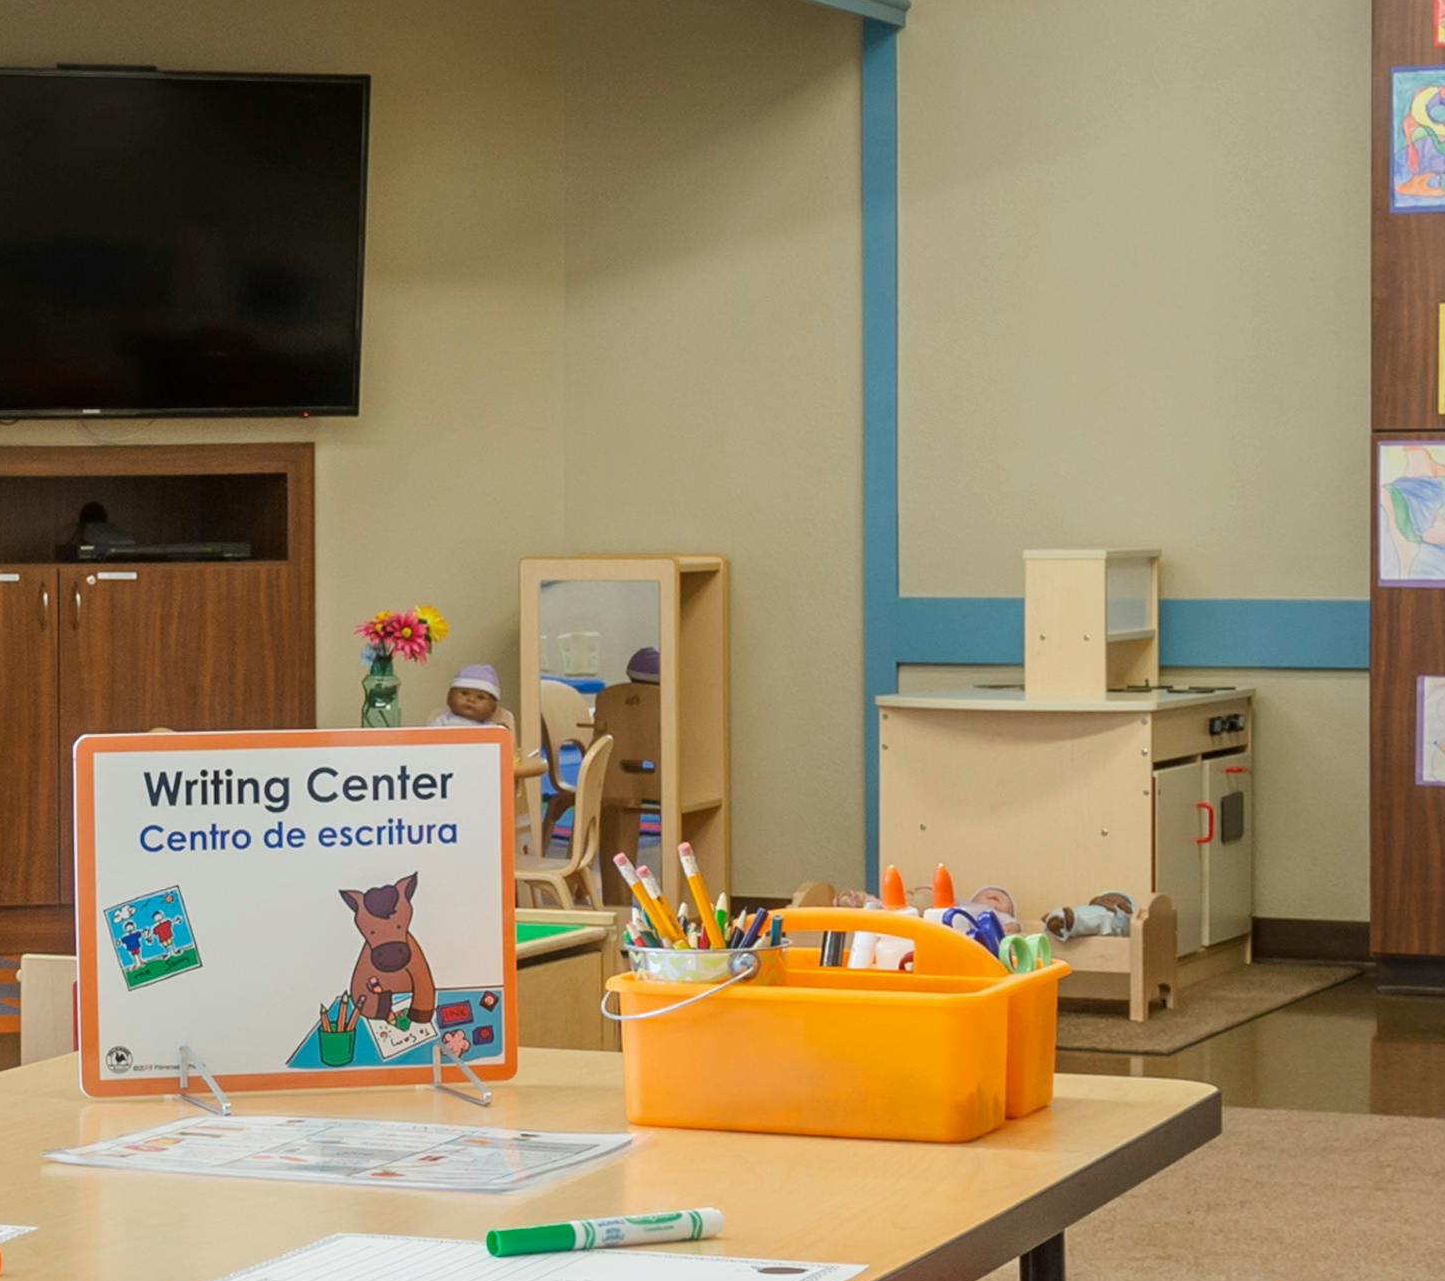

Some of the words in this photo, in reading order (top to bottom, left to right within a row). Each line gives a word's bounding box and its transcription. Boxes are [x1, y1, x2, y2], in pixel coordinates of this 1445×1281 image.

[143, 767, 291, 814] Writing
[306, 764, 454, 804] Center
[139, 822, 252, 853] Centro
[262, 820, 307, 850] de
[317, 817, 459, 849] escritura
